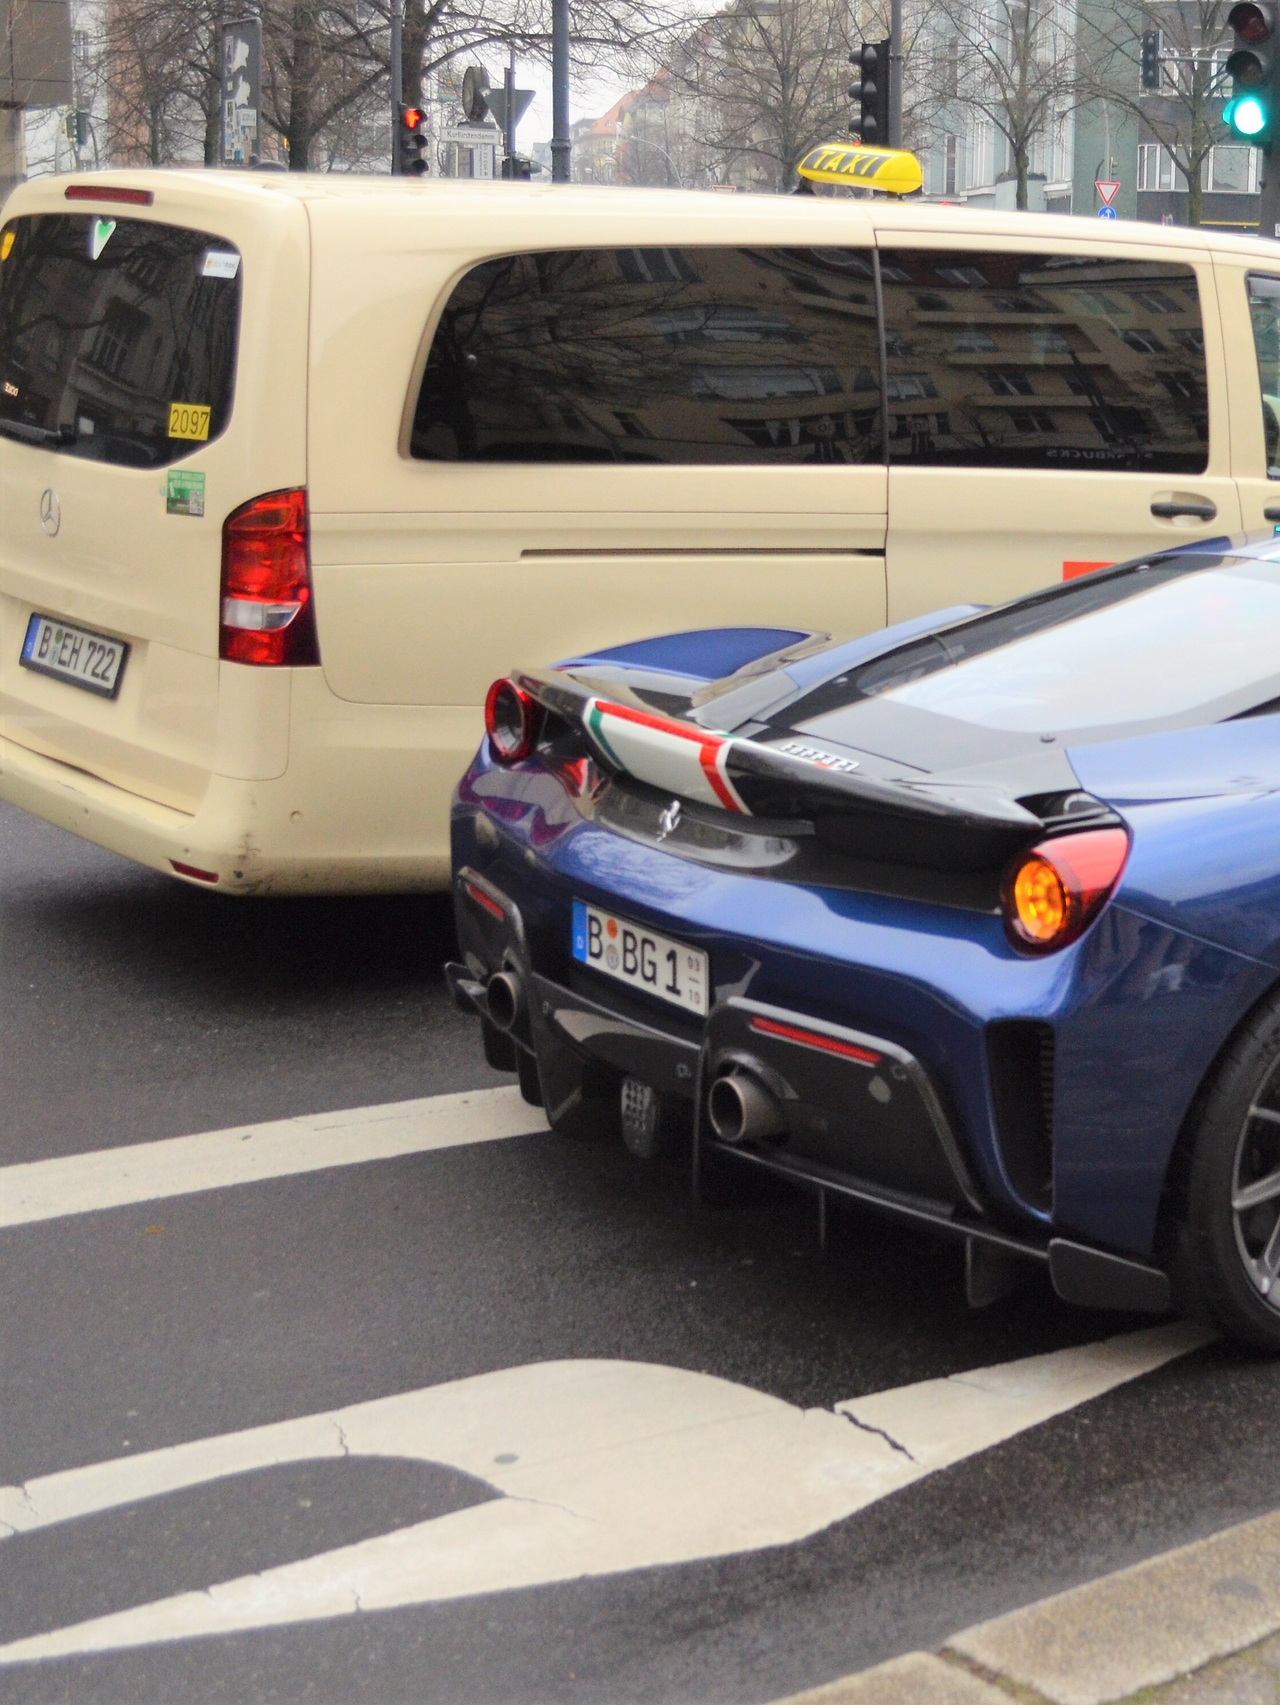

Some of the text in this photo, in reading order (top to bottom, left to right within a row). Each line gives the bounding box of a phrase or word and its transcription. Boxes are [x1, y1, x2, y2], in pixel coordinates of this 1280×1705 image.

[446, 130, 496, 141] Kurfürstendamm
[812, 150, 880, 175] TAXI
[170, 408, 209, 435] 2097
[38, 625, 116, 682] B EH 722
[588, 914, 681, 997] B BG 1
